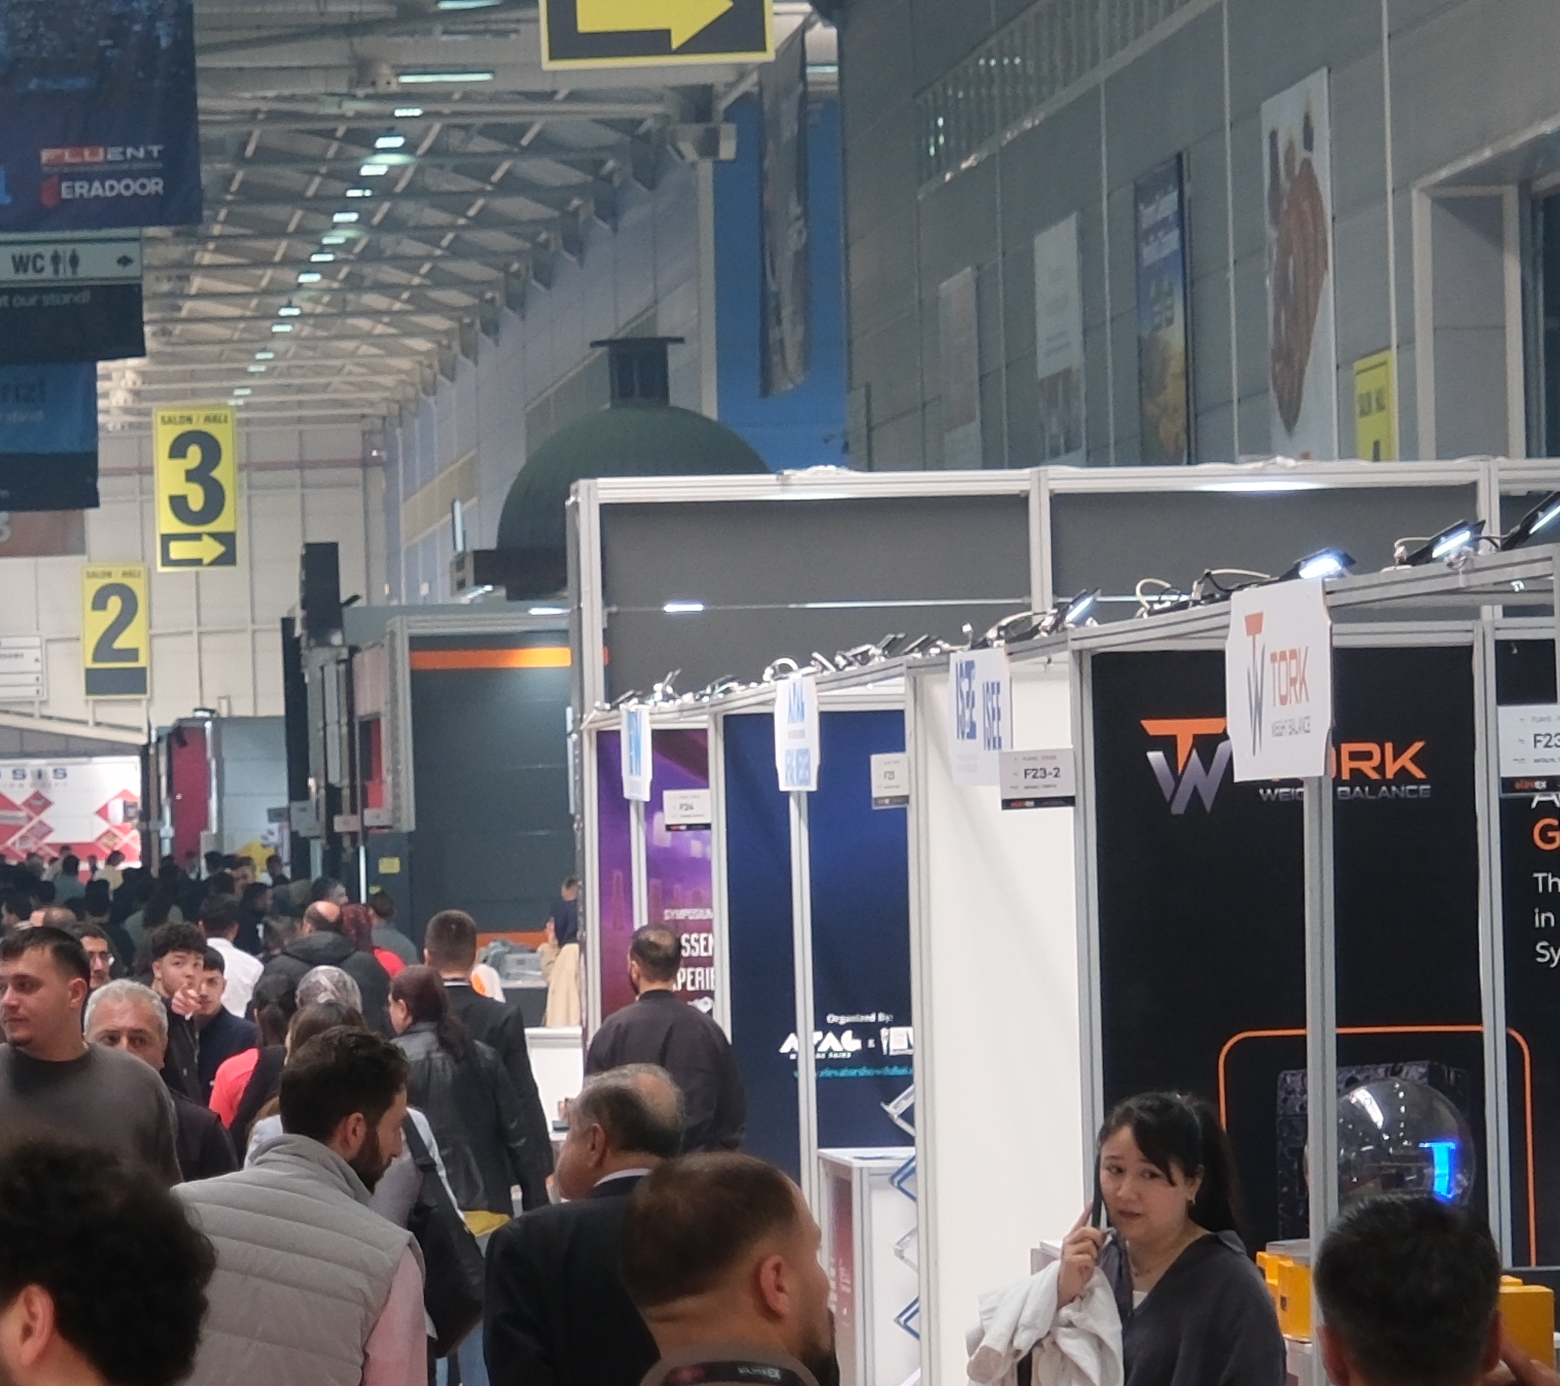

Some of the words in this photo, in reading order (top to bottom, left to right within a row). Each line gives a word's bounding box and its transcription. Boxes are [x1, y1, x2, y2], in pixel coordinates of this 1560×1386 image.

[60, 177, 164, 200] ERADOOR
[10, 253, 46, 276] WC
[168, 430, 226, 526] 3
[91, 582, 140, 664] 2
[1270, 646, 1310, 707] TORK
[1024, 767, 1061, 780] F23-2
[1337, 784, 1432, 800] BALANCE
[1534, 906, 1555, 929] in
